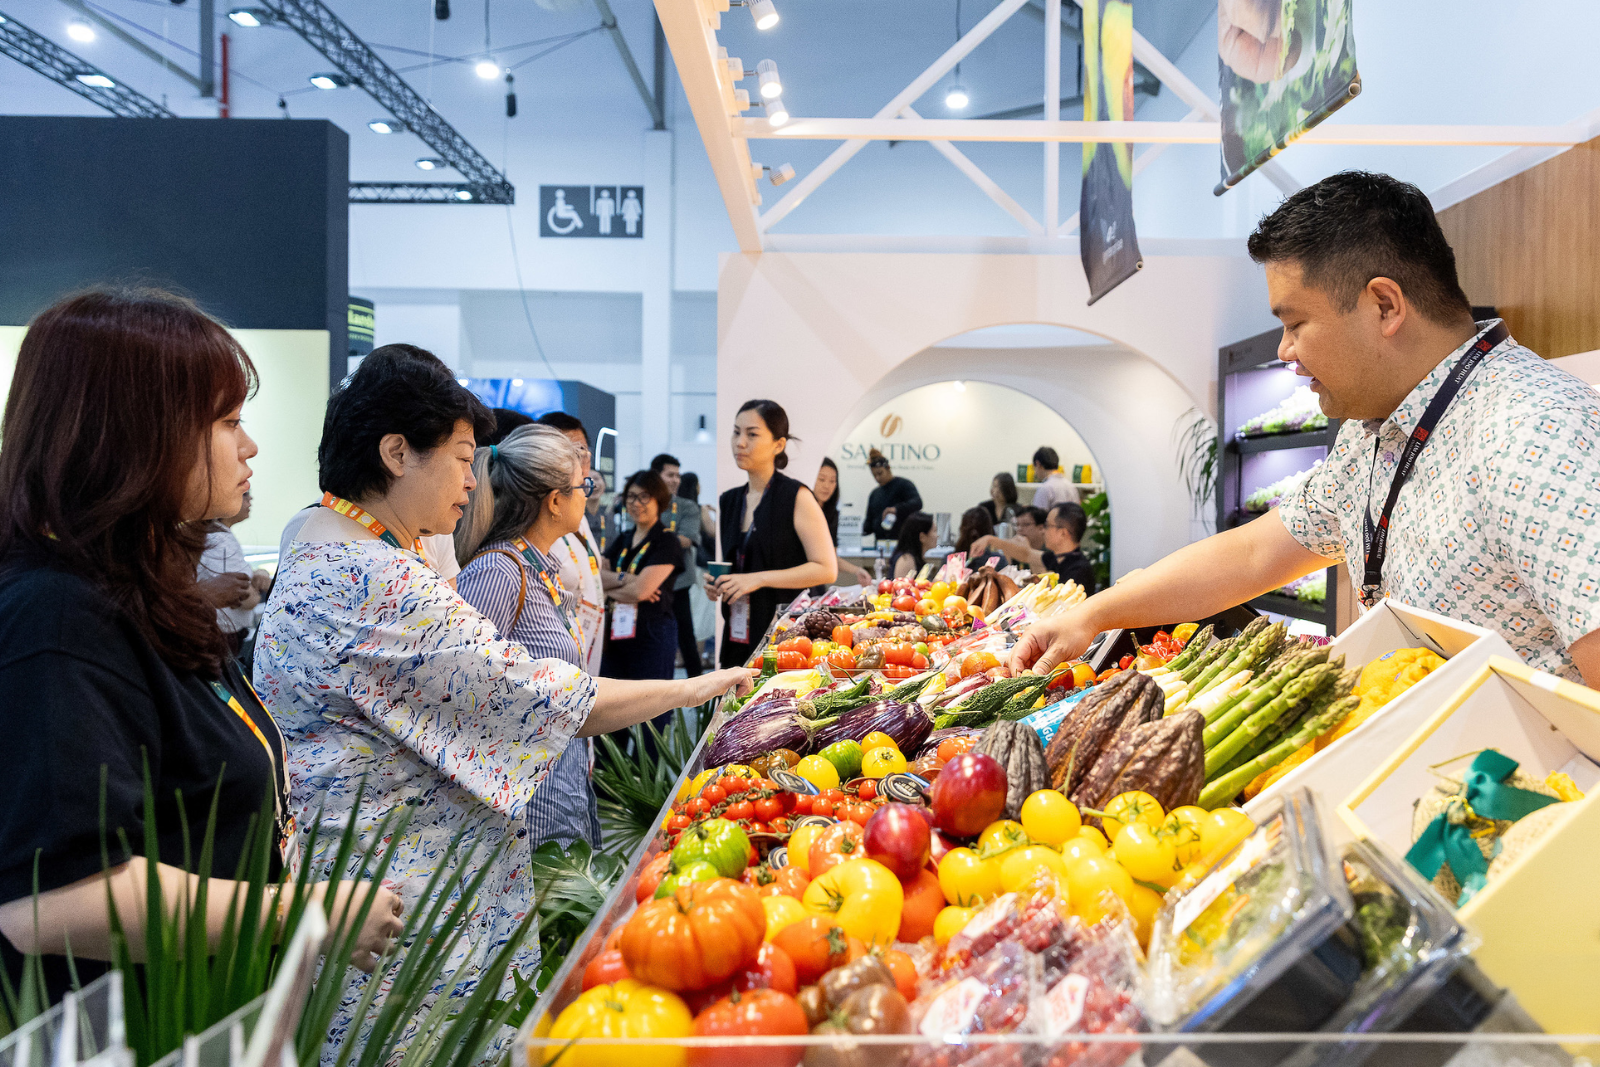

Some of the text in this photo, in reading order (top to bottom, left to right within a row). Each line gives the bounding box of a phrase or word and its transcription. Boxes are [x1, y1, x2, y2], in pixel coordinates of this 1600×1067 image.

[1454, 350, 1483, 384] LIM JOO HUAT
[1412, 441, 1421, 453] LIM
[1407, 451, 1416, 463] JOO
